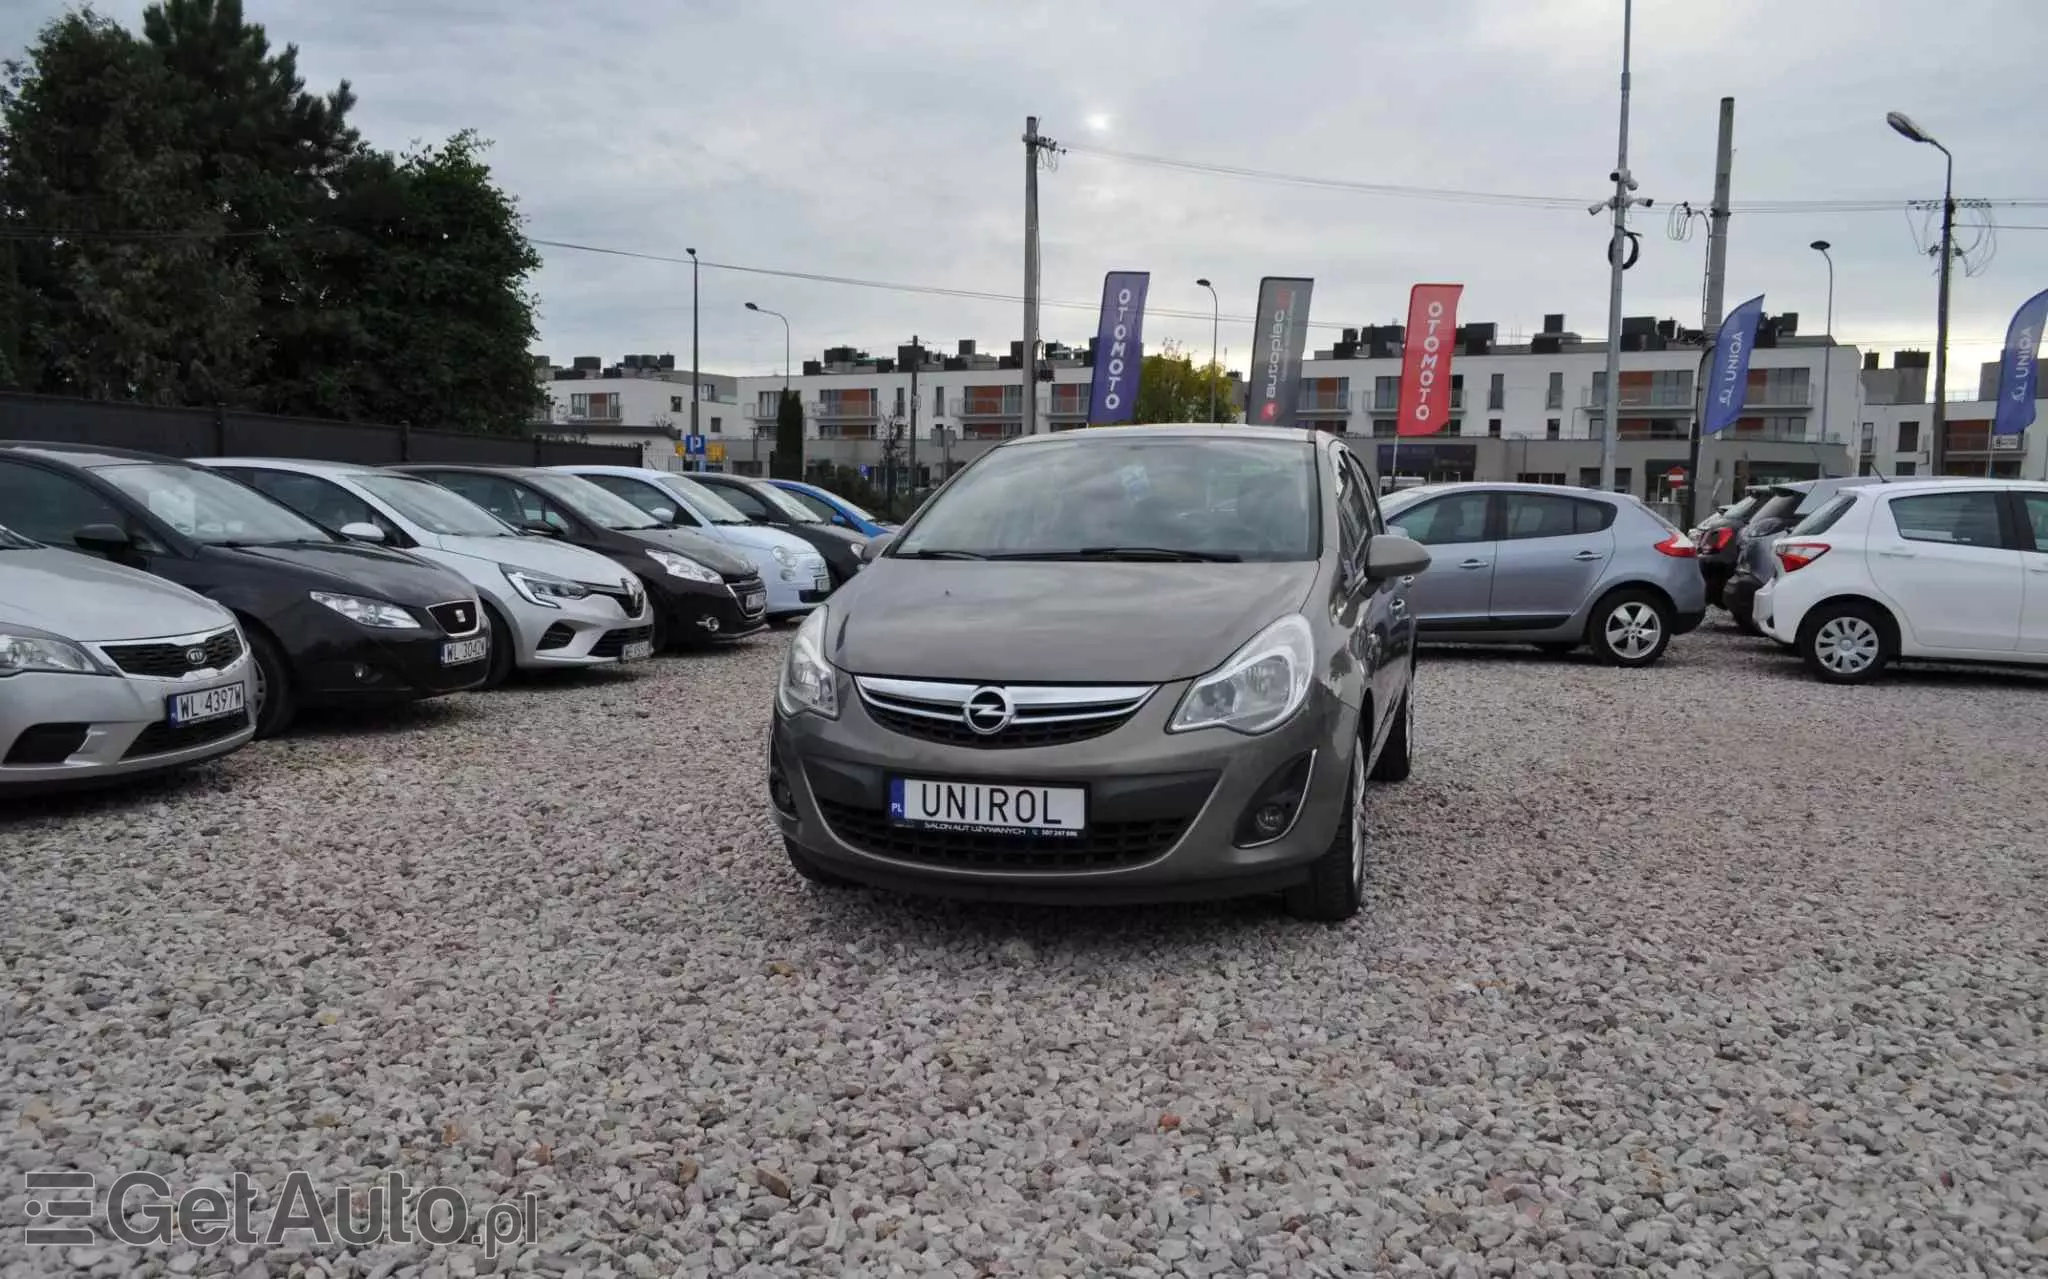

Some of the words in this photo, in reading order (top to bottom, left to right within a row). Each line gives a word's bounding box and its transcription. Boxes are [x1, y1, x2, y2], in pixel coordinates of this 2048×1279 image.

[1105, 288, 1131, 410] OTOMOTO
[1266, 309, 1286, 399] autoplac
[1415, 301, 1443, 421] OTOMOTO
[1725, 331, 1745, 382] UNIQA
[2016, 327, 2033, 378] UNIQA
[180, 695, 200, 719] WL
[205, 684, 242, 713] 4397W
[891, 803, 903, 813] PL
[922, 783, 1062, 825] UNIROL
[924, 822, 953, 831] SALON
[954, 824, 970, 832] AUT
